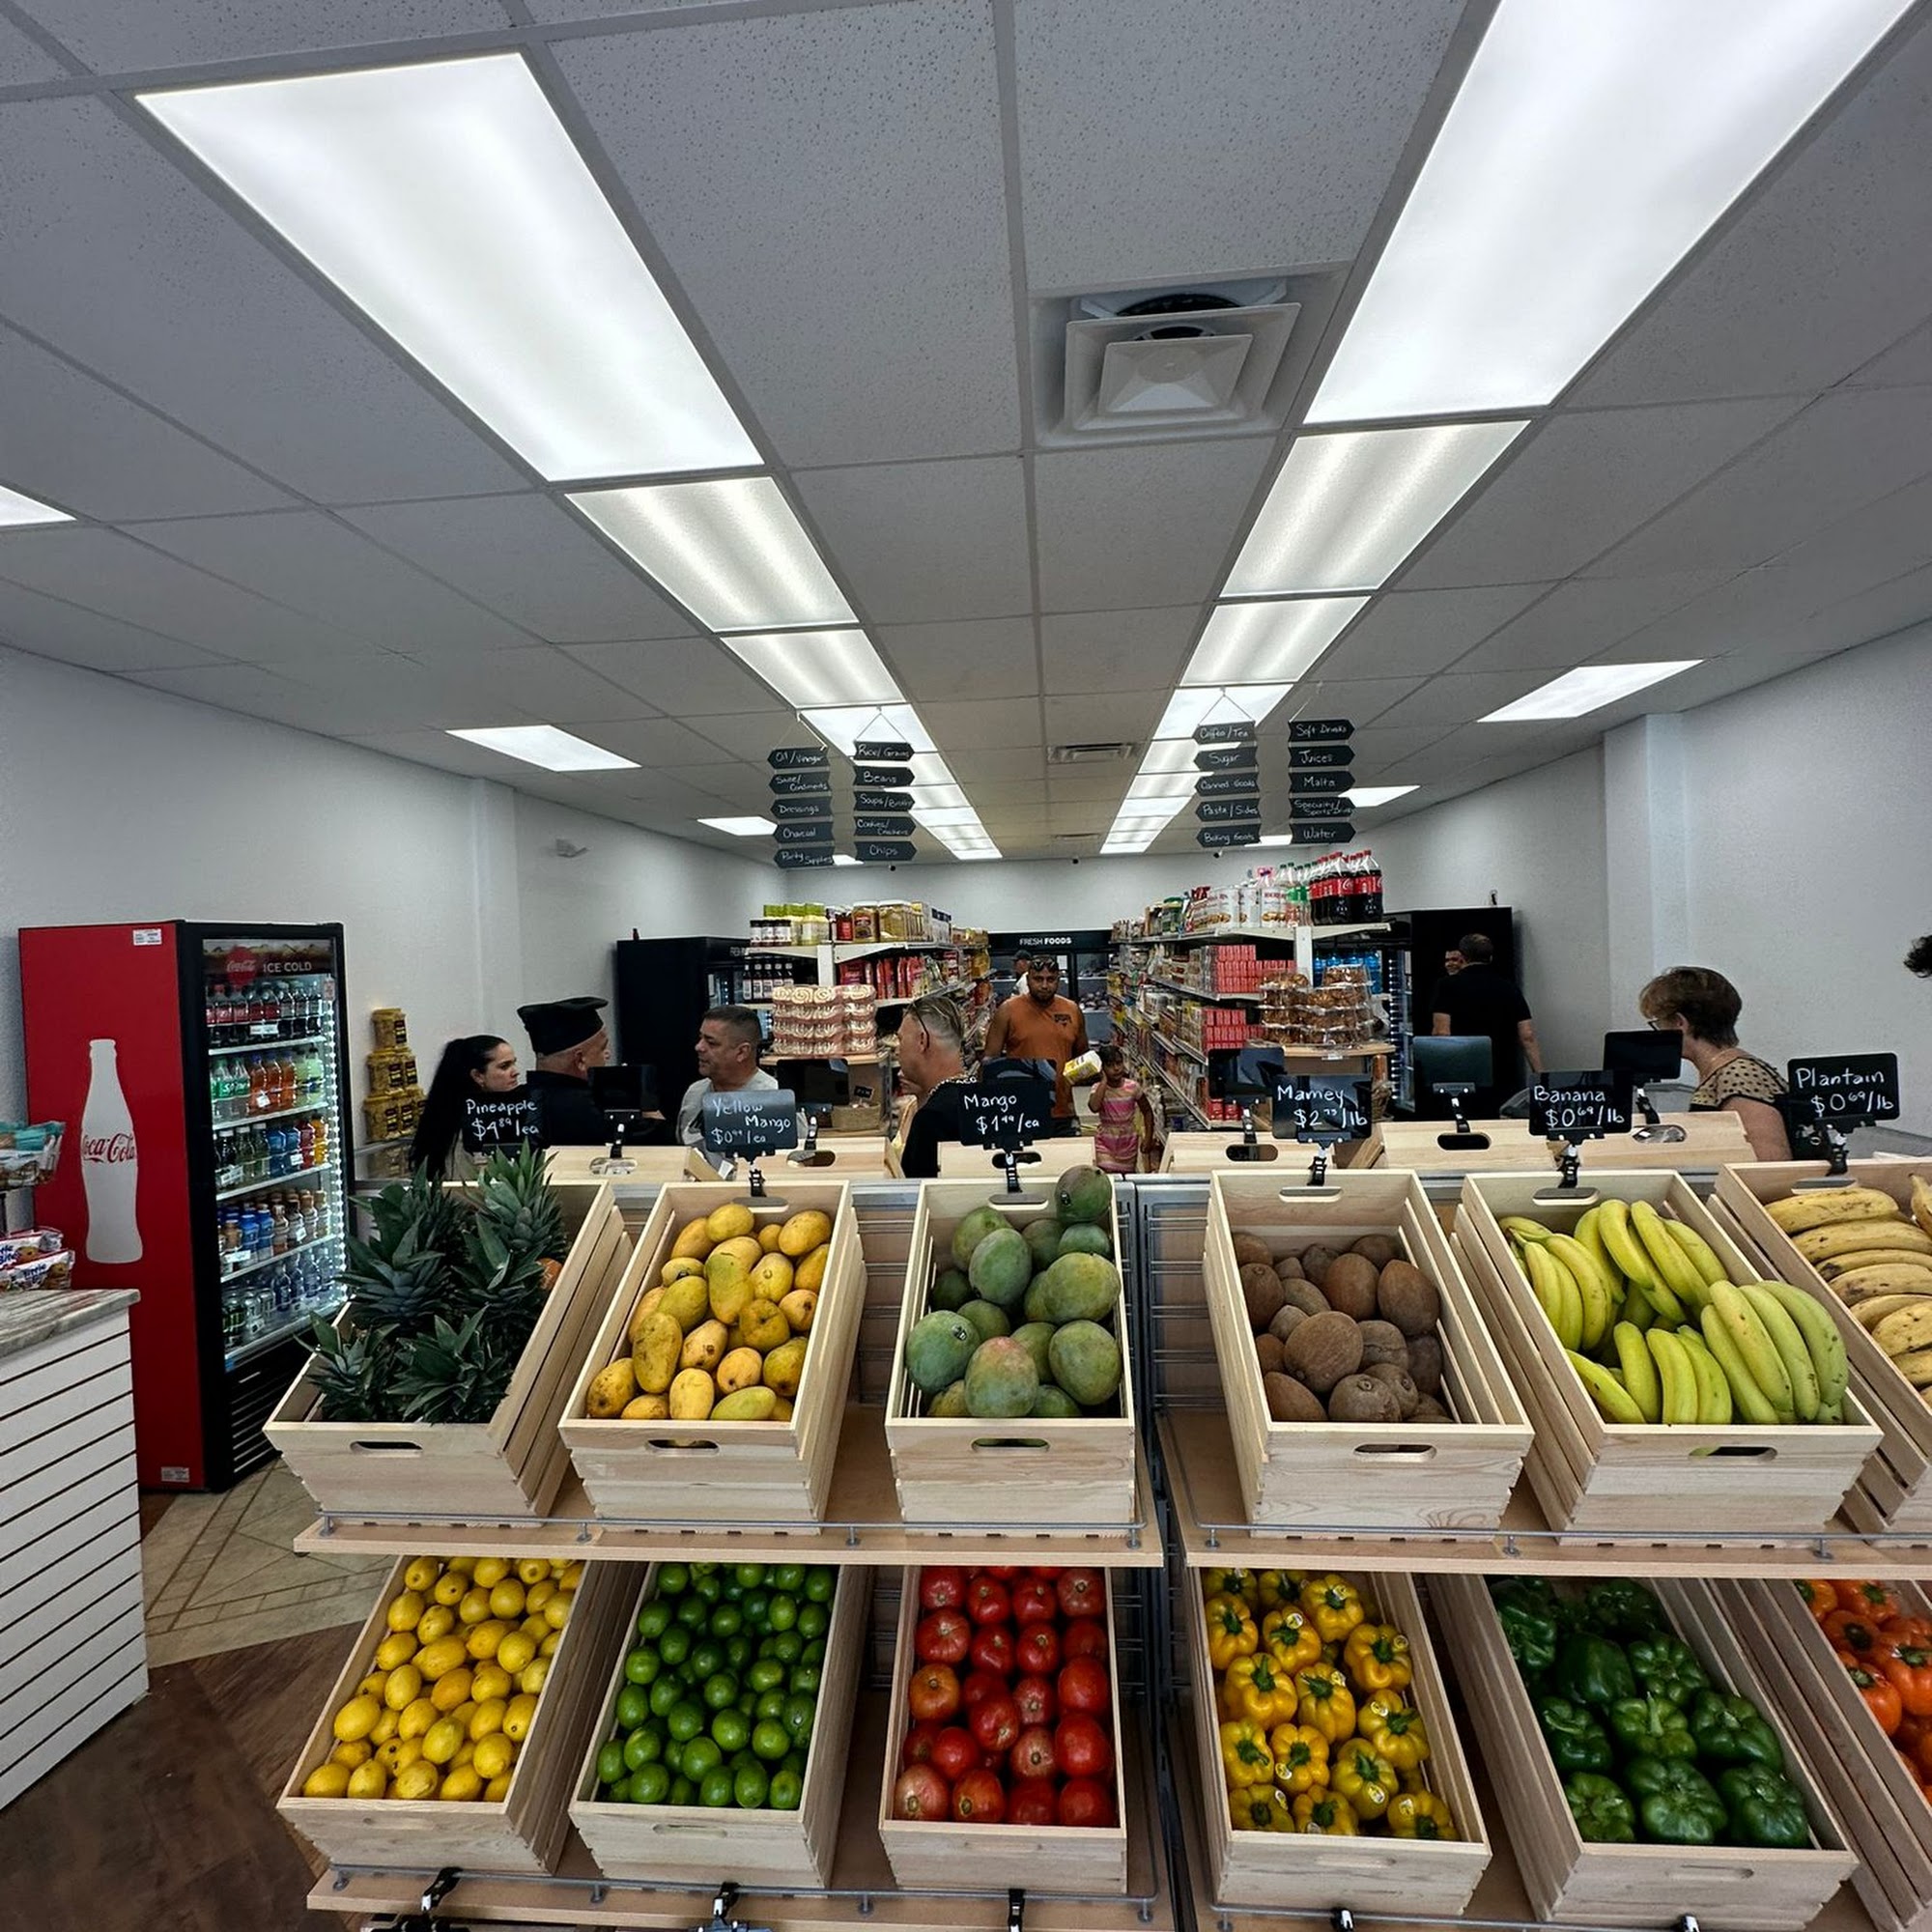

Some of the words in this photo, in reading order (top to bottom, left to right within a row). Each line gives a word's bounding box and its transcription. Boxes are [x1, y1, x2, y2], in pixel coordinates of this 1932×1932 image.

[1208, 752, 1241, 767] Sugar
[1298, 750, 1334, 764] Juices
[863, 770, 897, 783] Beans
[1303, 776, 1336, 787] Malta
[1303, 826, 1337, 840] Water
[869, 843, 899, 858] Chips
[1019, 937, 1043, 946] FRESH
[1043, 936, 1072, 945] FOODS
[263, 962, 282, 973] ICE
[283, 961, 312, 972] COLD
[1795, 1066, 1885, 1089] Plantain
[1276, 1084, 1345, 1108] Mamey
[1533, 1085, 1605, 1103] Banana
[466, 1098, 538, 1116] Pineapple
[712, 1097, 763, 1118] Yellow
[963, 1094, 1017, 1113] Mango
[744, 1114, 792, 1134] Mango
